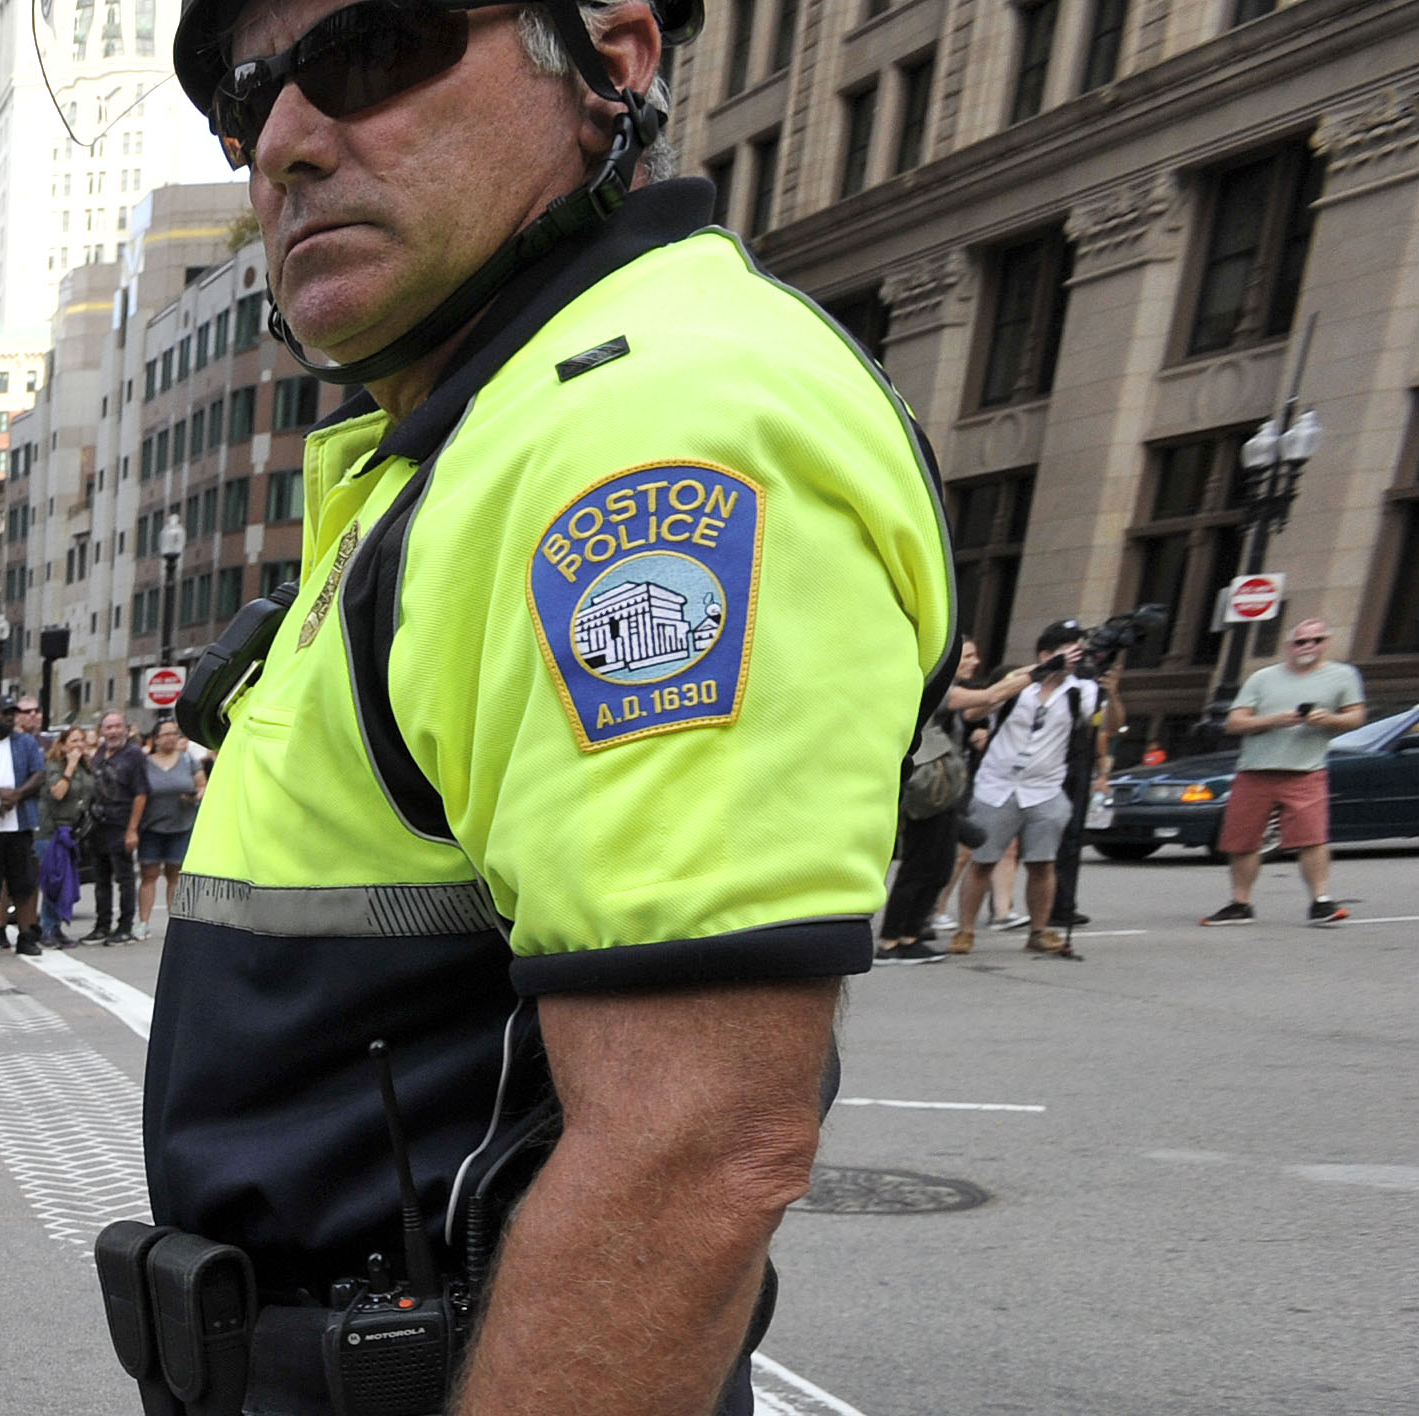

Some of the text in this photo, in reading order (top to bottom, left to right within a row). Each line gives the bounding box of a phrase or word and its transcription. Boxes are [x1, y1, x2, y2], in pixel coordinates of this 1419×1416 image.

[543, 479, 739, 564] BOSTON
[557, 513, 726, 583] POLICE
[596, 680, 718, 729] A.D. 1630
[364, 1327, 426, 1341] MOTOROLA
